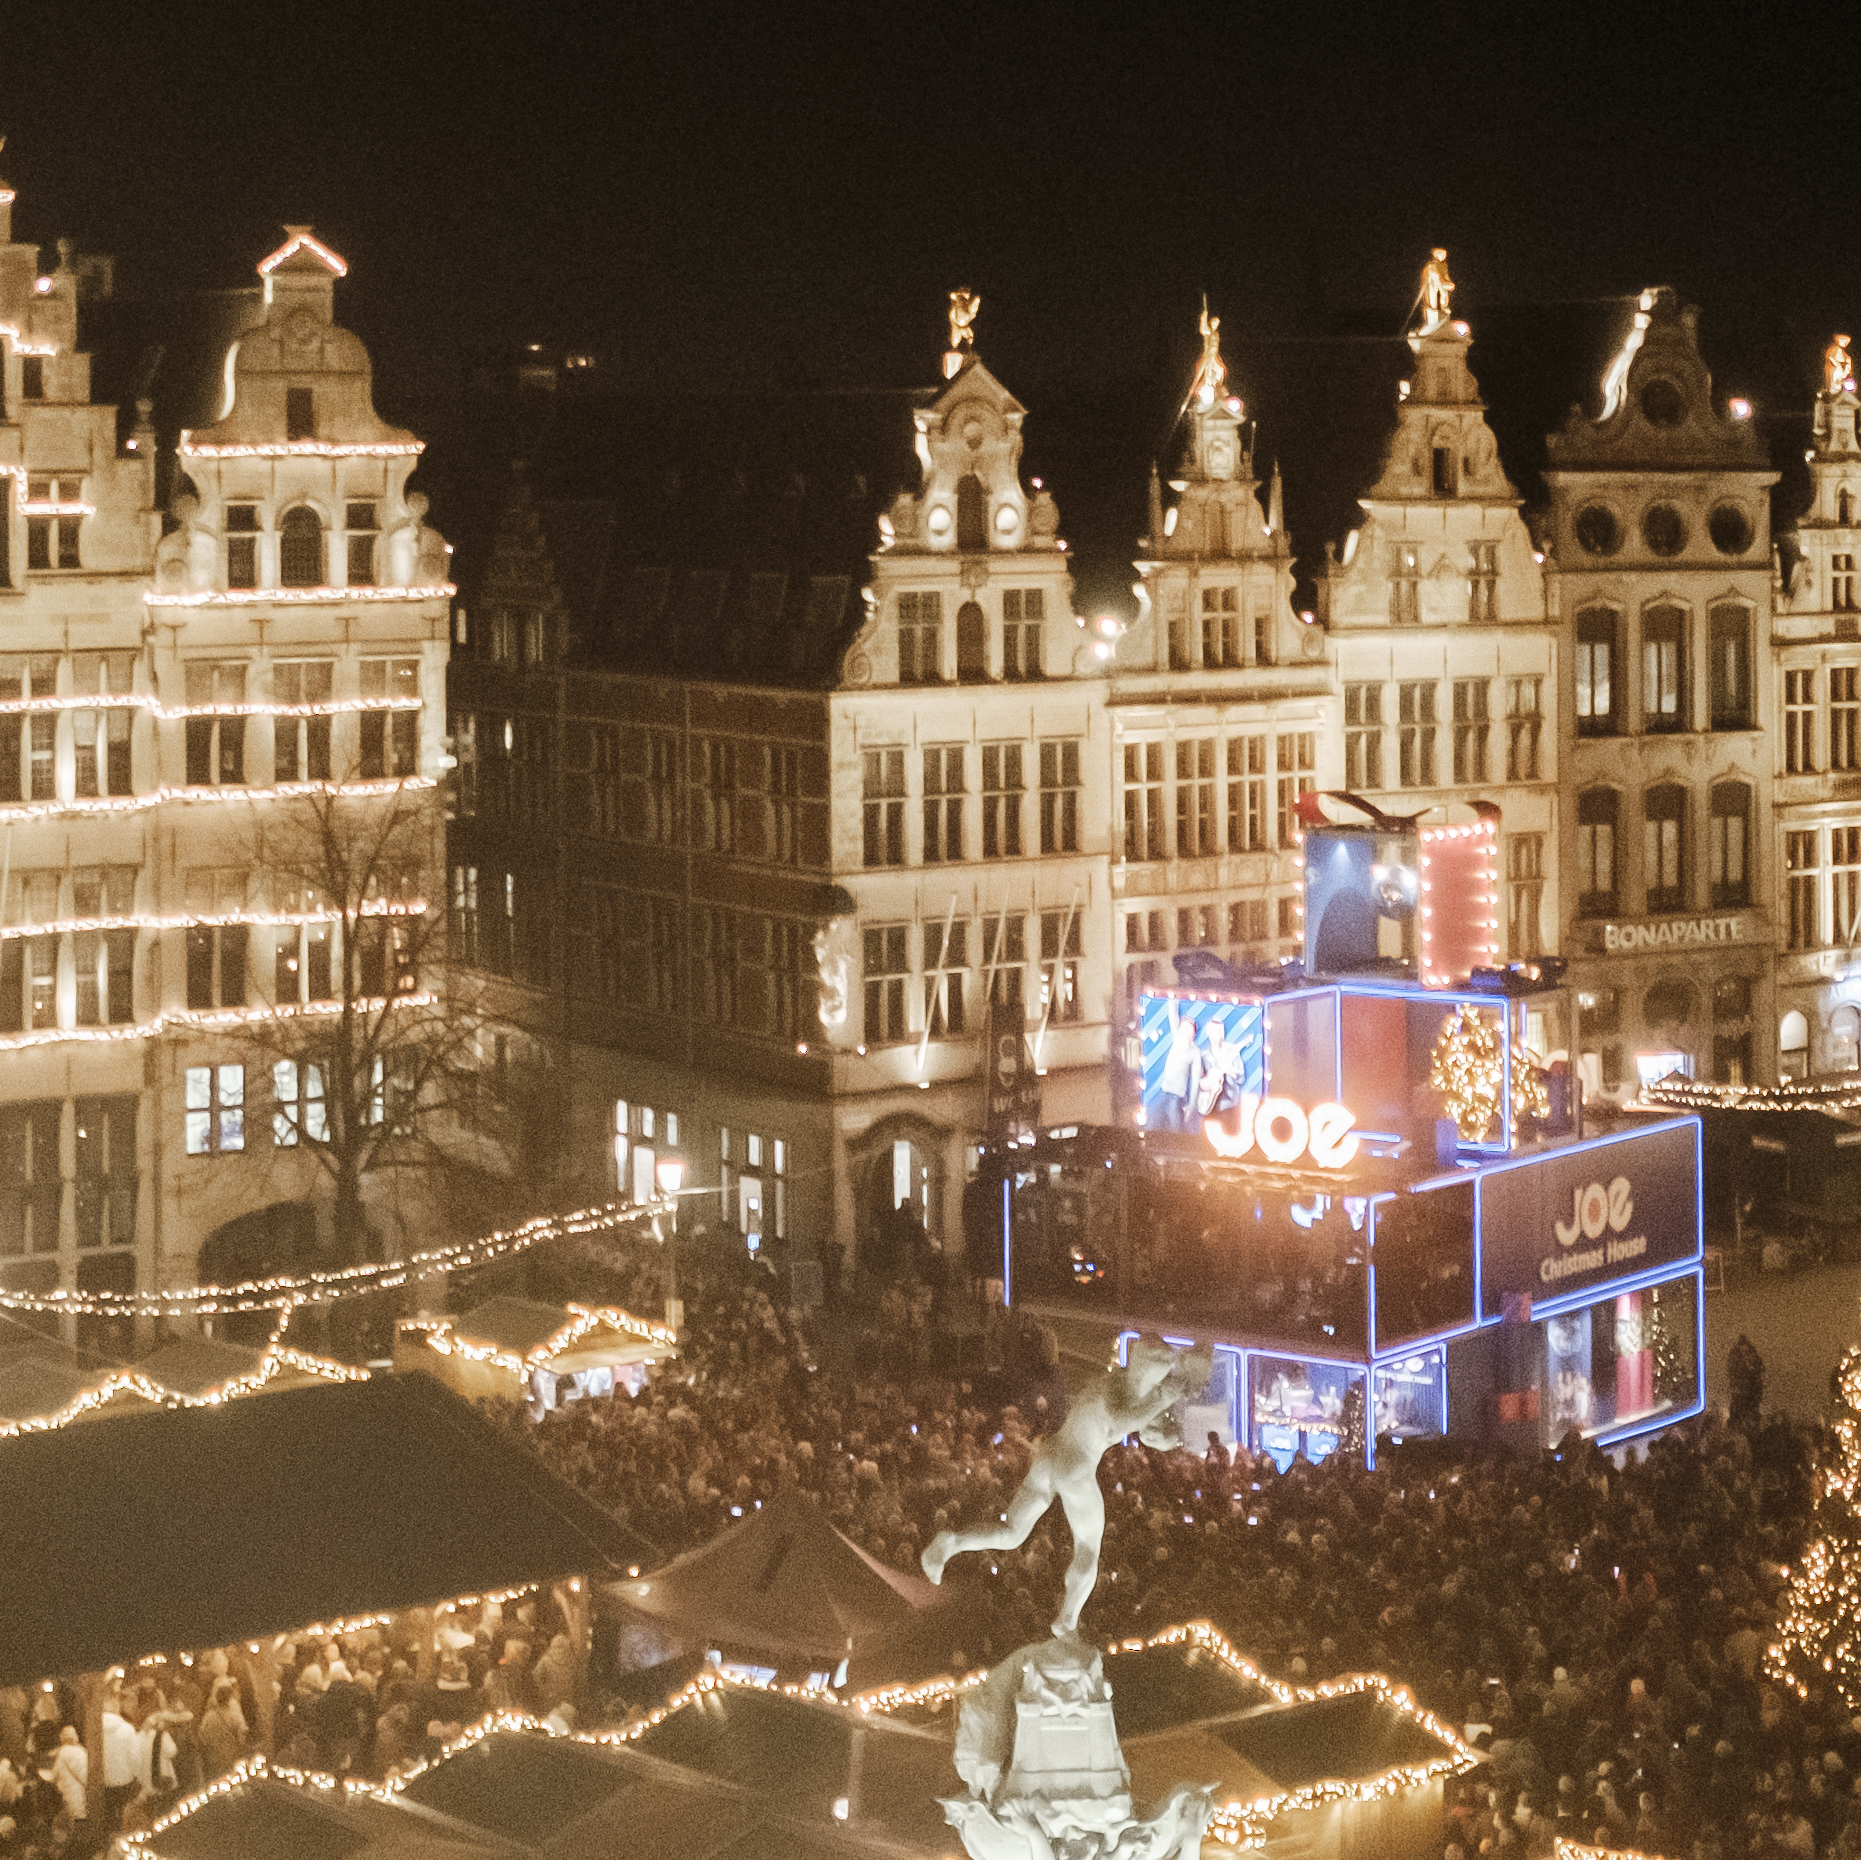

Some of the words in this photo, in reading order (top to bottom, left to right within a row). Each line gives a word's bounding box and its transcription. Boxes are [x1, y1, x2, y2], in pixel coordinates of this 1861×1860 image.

[1605, 918, 1744, 949] BONAPARTE
[1540, 1247, 1604, 1283] Christmas
[1607, 1235, 1647, 1264] House
